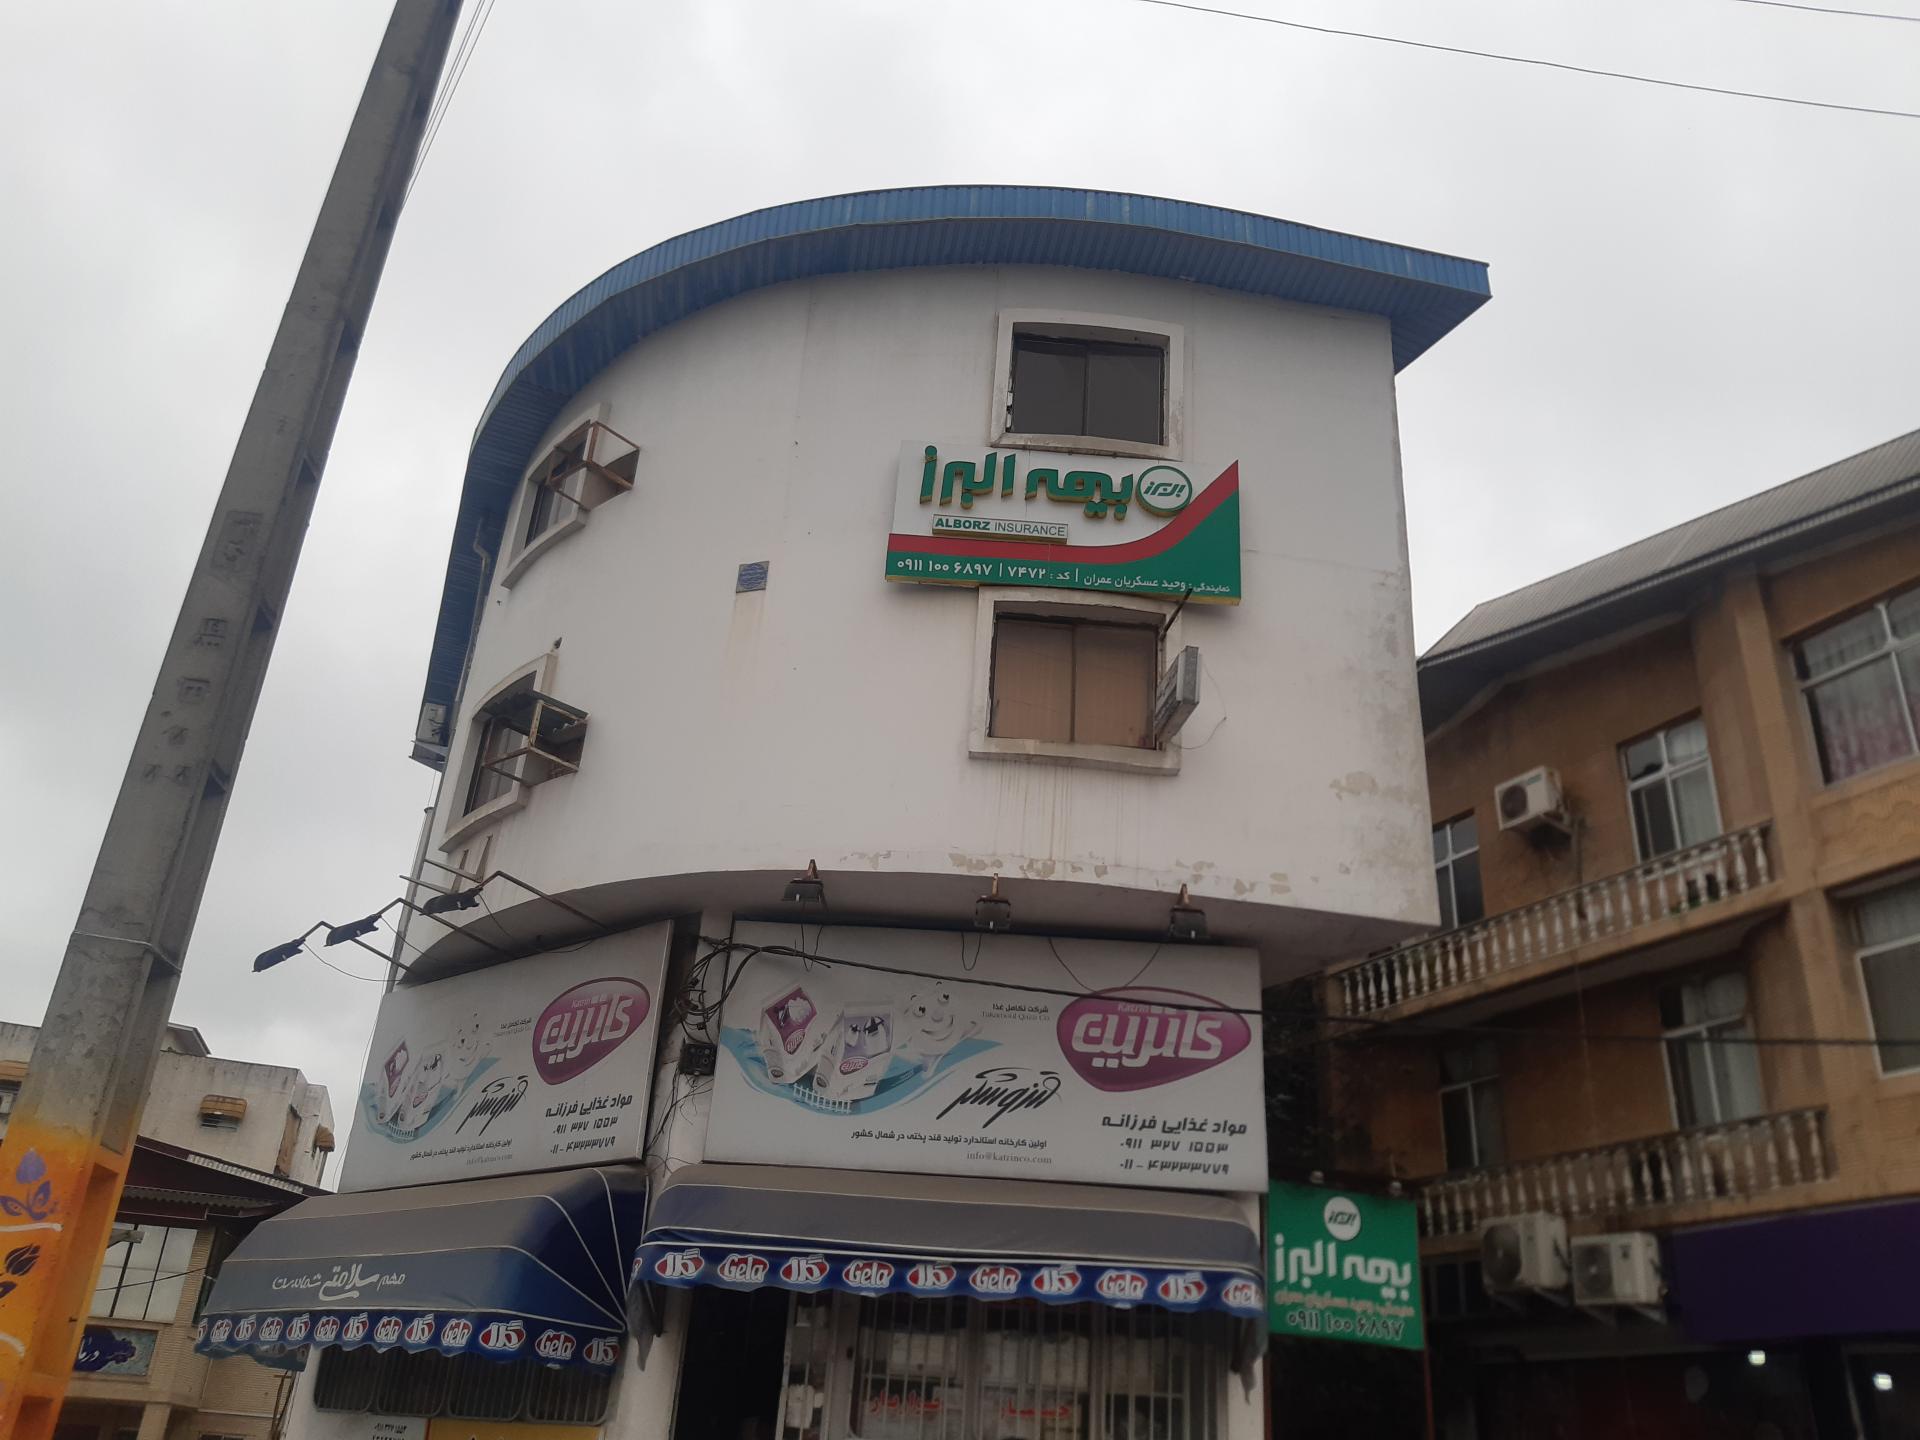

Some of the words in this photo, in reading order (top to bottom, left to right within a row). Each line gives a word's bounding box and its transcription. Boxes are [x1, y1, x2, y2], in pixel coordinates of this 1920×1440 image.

[920, 445, 1016, 509] البرز
[1024, 468, 1134, 521] بیمه
[935, 517, 991, 531] ALBORZ
[994, 522, 1066, 537] INSURANCE
[897, 558, 923, 572] ۰۹۱۱
[928, 561, 949, 573] ۱۰۰
[953, 562, 993, 576] ۶۸۹۷
[1007, 566, 1046, 580] ۷۴۷۲
[1083, 573, 1112, 586] عمران
[1161, 579, 1186, 591] وحید
[579, 1095, 609, 1116] غذایی
[609, 1093, 633, 1109] مواد
[1160, 1117, 1209, 1135] غذایی
[1211, 1119, 1248, 1136] مواد
[851, 1129, 873, 1140] کشور
[875, 1130, 896, 1140] شمال
[896, 1132, 905, 1142] در
[928, 1133, 942, 1142] قند
[942, 1134, 962, 1145] تولید
[963, 1135, 997, 1146] استاندارد
[998, 1137, 1027, 1148] کارخانه
[1028, 1139, 1047, 1149] اولین
[1119, 1137, 1143, 1150] ۰۹۱۱
[1150, 1138, 1182, 1151] ۳۲۷
[1188, 1141, 1230, 1154] ۱۵۵۳
[1274, 1232, 1337, 1289] البرز
[721, 1254, 768, 1281] Gela
[847, 1261, 892, 1287] Gela
[972, 1265, 1019, 1293] Gela
[1099, 1270, 1147, 1299] Gela
[1343, 1254, 1412, 1302] بیمه
[1286, 1309, 1320, 1332] ۰۹۱۱
[1323, 1312, 1354, 1333] ۱۰۰
[315, 1317, 340, 1341] Gela
[375, 1317, 401, 1342] Gela
[443, 1319, 472, 1346] Gela
[538, 1330, 573, 1358] Gela
